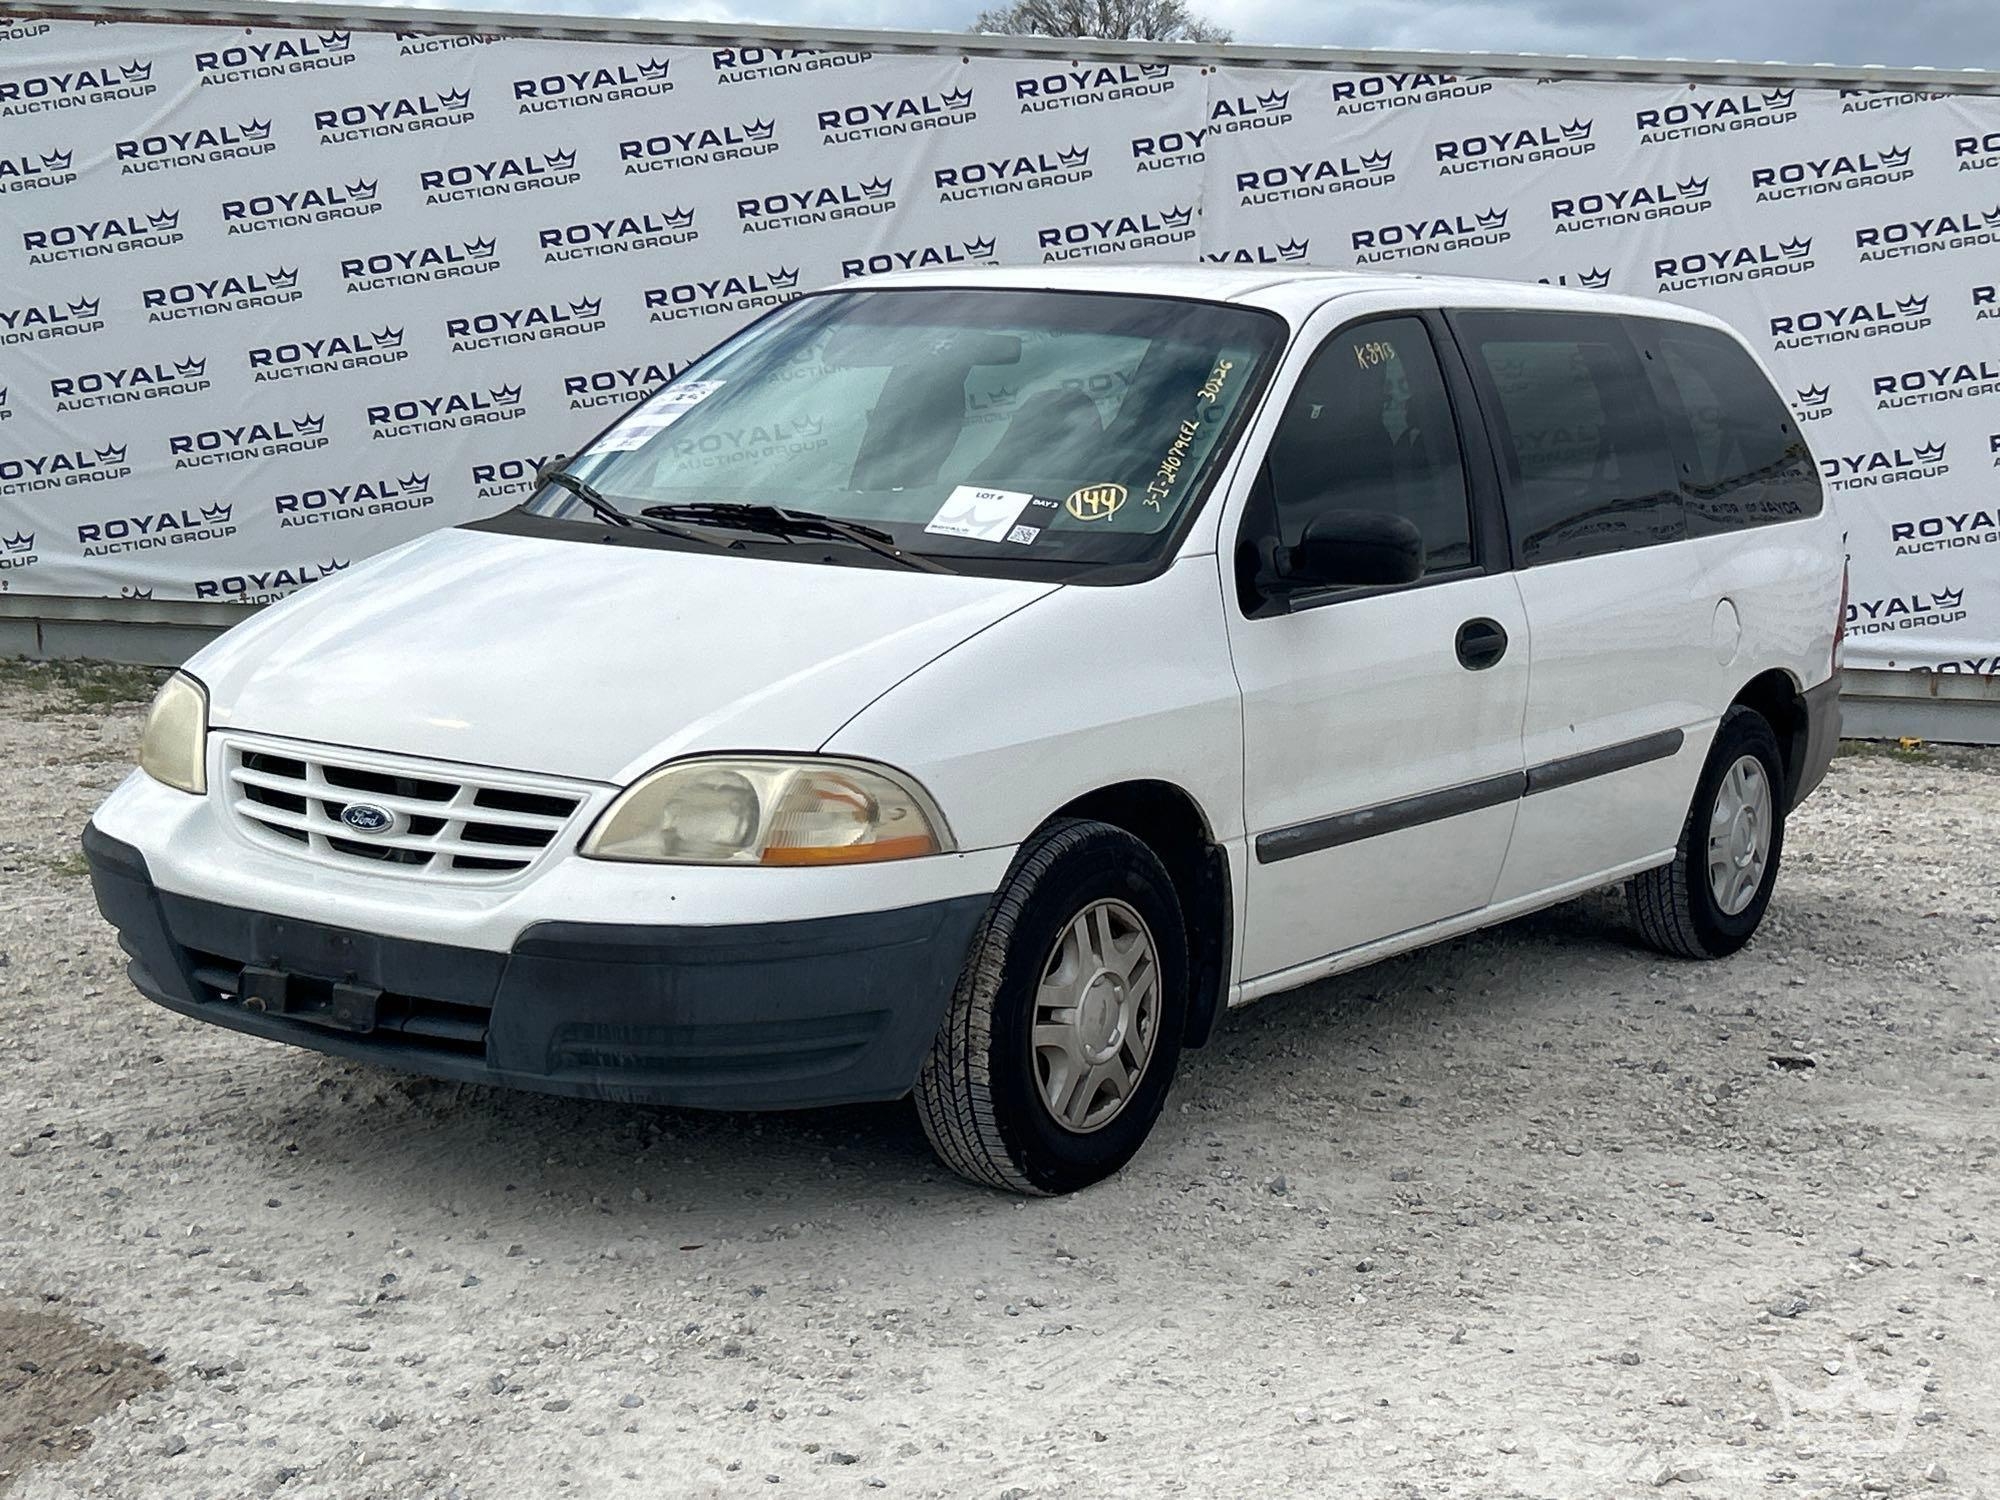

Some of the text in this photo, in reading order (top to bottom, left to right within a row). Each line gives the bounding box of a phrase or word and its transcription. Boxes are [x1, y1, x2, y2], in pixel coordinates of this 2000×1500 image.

[195, 38, 319, 72] ROYAL
[398, 34, 484, 56] AUCTION
[0, 68, 120, 102] ROYAL
[201, 54, 355, 87] AUCTION GROUP
[513, 66, 638, 100] ROYAL
[717, 52, 873, 85] AUCTION GROUP
[1015, 65, 1139, 99] ROYAL
[2, 84, 157, 116] AUCTION GROUP
[314, 96, 439, 130] ROYAL
[518, 83, 674, 114] AUCTION GROUP
[818, 96, 941, 130] ROYAL
[1019, 81, 1175, 114] AUCTION GROUP
[1336, 83, 1492, 116] AUCTION GROUP
[1636, 96, 1761, 130] ROYAL
[1841, 92, 1928, 114] AUCTION
[319, 112, 475, 145] AUCTION GROUP
[822, 112, 977, 145] AUCTION GROUP
[1225, 114, 1292, 133] GROUP
[1640, 112, 1797, 145] AUCTION GROUP
[115, 126, 240, 160] ROYAL
[121, 143, 276, 175] AUCTION GROUP
[619, 126, 743, 160] ROYAL
[624, 143, 779, 175] AUCTION GROUP
[1131, 129, 1207, 158] ROY
[1435, 127, 1560, 161] ROYAL
[1439, 143, 1596, 176] AUCTION GROUP
[420, 156, 545, 190] ROYAL
[935, 154, 1058, 188] ROYAL
[1136, 152, 1206, 172] AUCTIO
[1236, 158, 1360, 191] ROYAL
[1752, 153, 1878, 188] ROYAL
[11, 173, 77, 192] GROUP
[426, 173, 581, 205] AUCTION GROUP
[939, 170, 1093, 203] AUCTION GROUP
[1240, 174, 1395, 206] AUCTION GROUP
[1756, 170, 1914, 203] AUCTION GROUP
[222, 187, 346, 220] ROYAL
[737, 185, 861, 219] ROYAL
[742, 201, 896, 233] AUCTION GROUP
[1551, 184, 1676, 219] ROYAL
[1555, 201, 1712, 234] AUCTION GROUP
[23, 217, 148, 250] ROYAL
[227, 203, 382, 235] AUCTION GROUP
[539, 215, 663, 248] ROYAL
[1038, 214, 1161, 248] ROYAL
[1352, 216, 1475, 250] ROYAL
[1856, 214, 1982, 247] ROYAL
[29, 233, 184, 265] AUCTION GROUP
[341, 245, 465, 278] ROYAL
[544, 231, 699, 263] AUCTION GROUP
[842, 244, 965, 279] ROYAL
[1043, 230, 1196, 262] AUCTION GROUP
[1355, 232, 1511, 264] AUCTION GROUP
[1654, 244, 1779, 278] ROYAL
[1861, 241, 1945, 263] AUCTION
[143, 275, 267, 308] ROYAL
[346, 261, 501, 293] AUCTION GROUP
[645, 275, 769, 308] ROYAL
[1658, 261, 1815, 293] AUCTION GROUP
[0, 305, 69, 330] YAL
[148, 291, 303, 323] AUCTION GROUP
[447, 304, 570, 338] ROYAL
[649, 291, 804, 323] AUCTION GROUP
[1770, 302, 1896, 336] ROYAL
[37, 321, 104, 340] GROUP
[452, 321, 606, 352] AUCTION GROUP
[1774, 318, 1932, 351] AUCTION GROUP
[249, 334, 373, 368] ROYAL
[254, 351, 409, 382] AUCTION GROUP
[51, 364, 175, 397] ROYAL
[1874, 362, 1999, 396] ROYAL
[56, 380, 211, 412] AUCTION GROUP
[367, 392, 490, 425] ROYAL
[1877, 388, 1963, 411] AUCTION
[169, 422, 293, 455] ROYAL
[372, 408, 526, 439] AUCTION GROUP
[0, 452, 95, 480] OYAL
[175, 438, 329, 469] AUCTION GROUP
[1820, 449, 1914, 478] OYAL
[0, 468, 131, 497] CTION GROUP
[478, 482, 536, 499] AUCTI
[1833, 465, 1949, 491] TION GROUP
[275, 480, 399, 513] ROYAL
[280, 496, 434, 528] AUCTION GROUP
[78, 510, 201, 543] ROYAL
[1891, 508, 2000, 541] ROYA
[83, 526, 237, 557] AUCTION GROUP
[1893, 534, 1980, 557] AUCTION
[0, 555, 38, 569] OUP
[195, 567, 319, 600] ROYAL
[1899, 611, 1966, 630] GROUP
[351, 808, 379, 826] Ford
